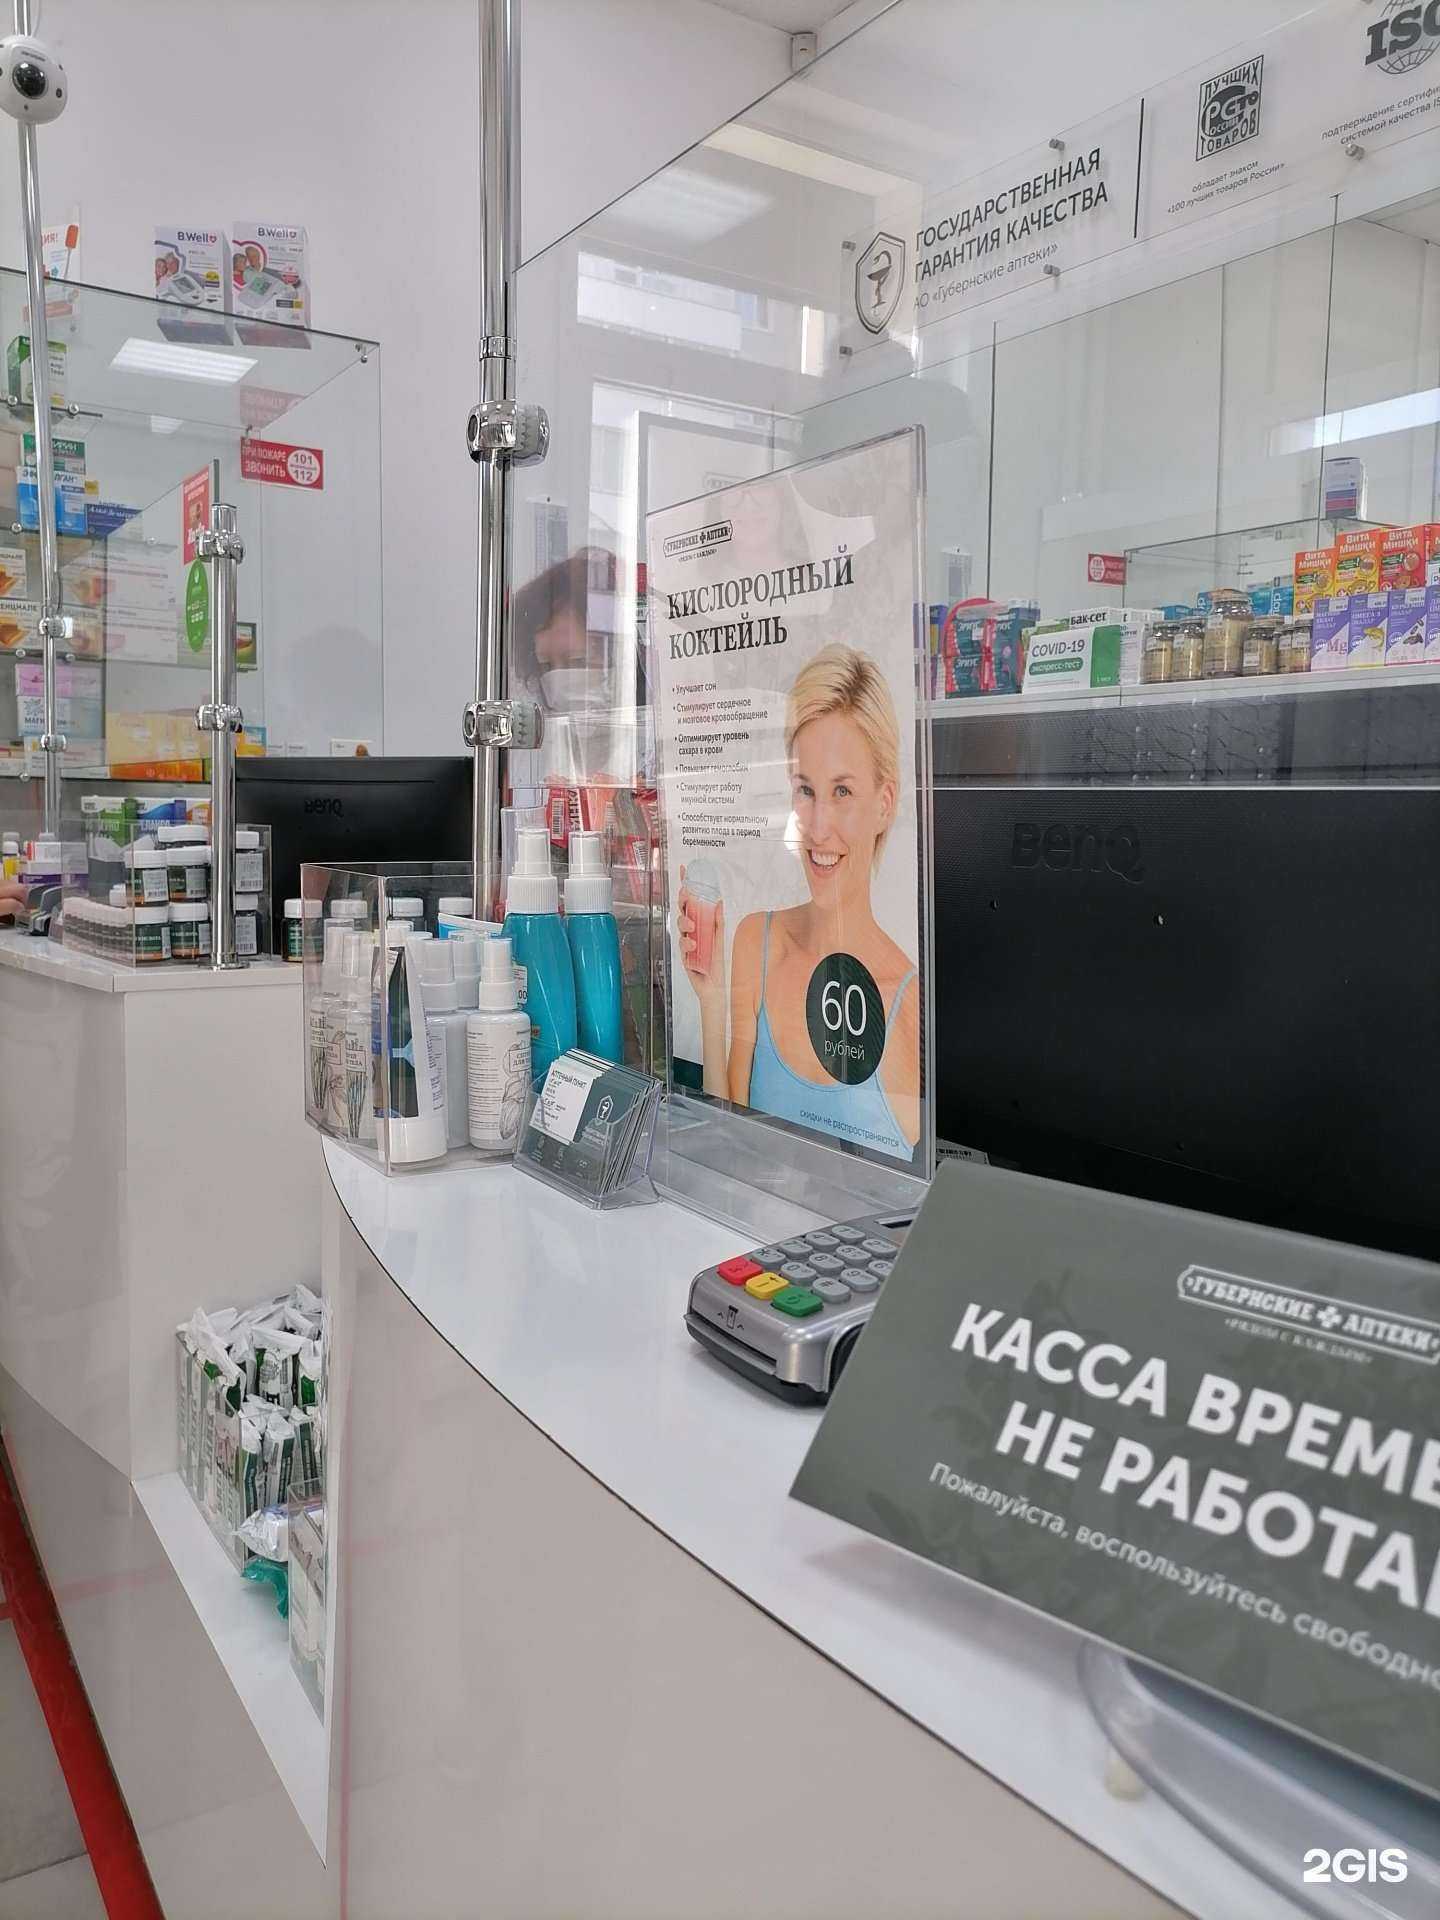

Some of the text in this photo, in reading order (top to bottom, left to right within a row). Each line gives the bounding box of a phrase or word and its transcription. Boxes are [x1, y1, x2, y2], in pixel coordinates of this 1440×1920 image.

[1203, 60, 1260, 108] ЛУЧШИХ
[1200, 109, 1256, 155] ТОВАРОВ
[1322, 104, 1395, 140] подтверждение
[1340, 119, 1387, 144] системой
[1388, 103, 1431, 126] качества
[1192, 160, 1259, 193] обладает знаком
[1215, 177, 1249, 196] товаров
[1249, 162, 1286, 182] России»
[916, 147, 1100, 251] ГОСУДАРСТВЕННАЯ
[41, 232, 59, 246] ИЯ!
[177, 231, 209, 243] B.Well
[257, 227, 289, 239] B.Well
[915, 181, 1108, 283] ГАРАНТИЯ КАЧЕСТВА
[933, 264, 1004, 303] «Губернские
[1007, 243, 1058, 273] аптеки»
[258, 447, 287, 462] ПОЖАРЕ
[293, 453, 313, 465] 101
[245, 460, 286, 478] ЗВОНИТЬ
[293, 469, 313, 482] 112
[667, 544, 854, 619] КИСЛОРОДНЫЙ
[669, 611, 788, 660] КОКТЕЙЛЬ
[1031, 638, 1085, 658] COVID-19
[1327, 639, 1348, 655] Mg
[676, 682, 717, 695] Улучшает сон
[676, 698, 752, 714] Стимулирует сердечное
[711, 709, 768, 724] кровообращение
[679, 730, 750, 744] Оптимизирует уровень
[679, 747, 699, 757] сахара
[705, 745, 723, 756] крови
[680, 781, 742, 794] Стимулирует работу
[708, 795, 735, 804] системы
[681, 811, 769, 827] Способствует нормальному
[682, 825, 711, 836] развитию
[711, 826, 731, 836] плода
[736, 828, 761, 839] период
[682, 837, 727, 849] беременности
[821, 979, 868, 1038] 60
[824, 1039, 865, 1061] рублей
[799, 1109, 900, 1149] скидки не распространяются
[1191, 1275, 1431, 1351] ГУБЕРНСКИЕ АПТЕКИ
[951, 1302, 1168, 1418] КАССА
[995, 1400, 1095, 1481] НЕ
[929, 1461, 1069, 1540] Пожалуйста,
[1075, 1525, 1288, 1623] воспользуйтесь
